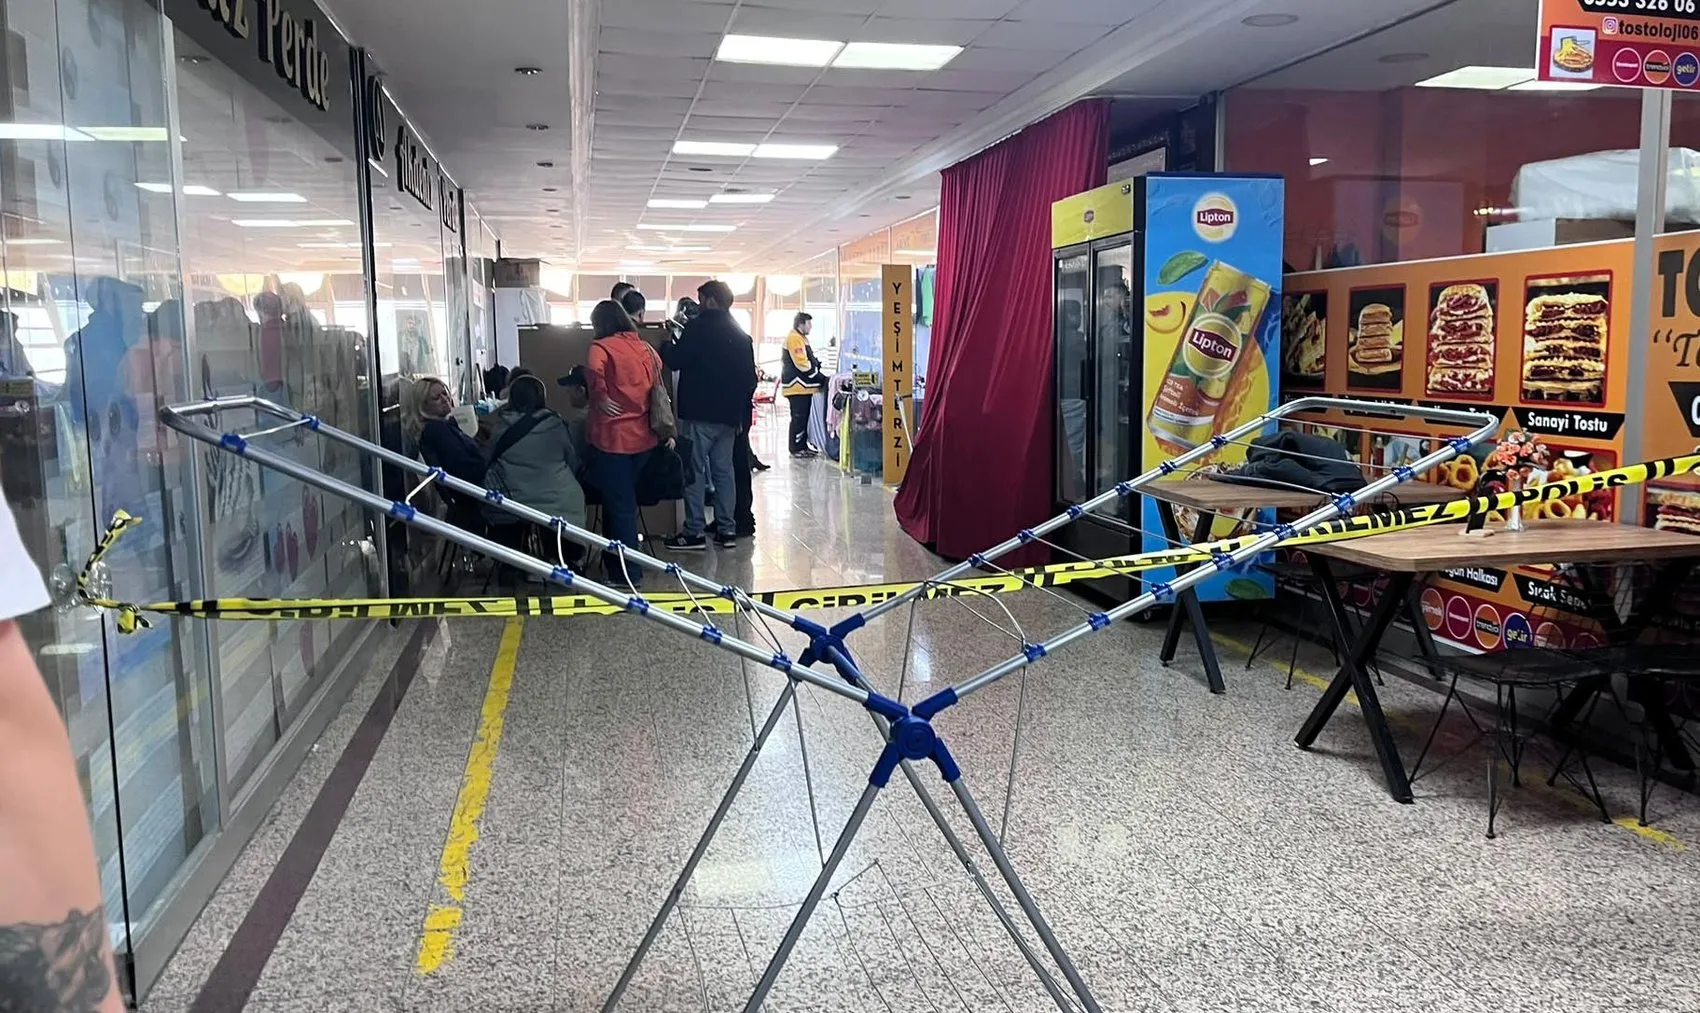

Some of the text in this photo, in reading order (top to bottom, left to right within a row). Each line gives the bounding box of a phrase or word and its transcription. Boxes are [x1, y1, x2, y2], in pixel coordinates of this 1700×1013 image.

[1200, 212, 1231, 223] Lipton
[892, 282, 903, 373] YEŞİM
[1193, 331, 1233, 359] Lipton
[1528, 411, 1608, 432] Sanayi Tostu
